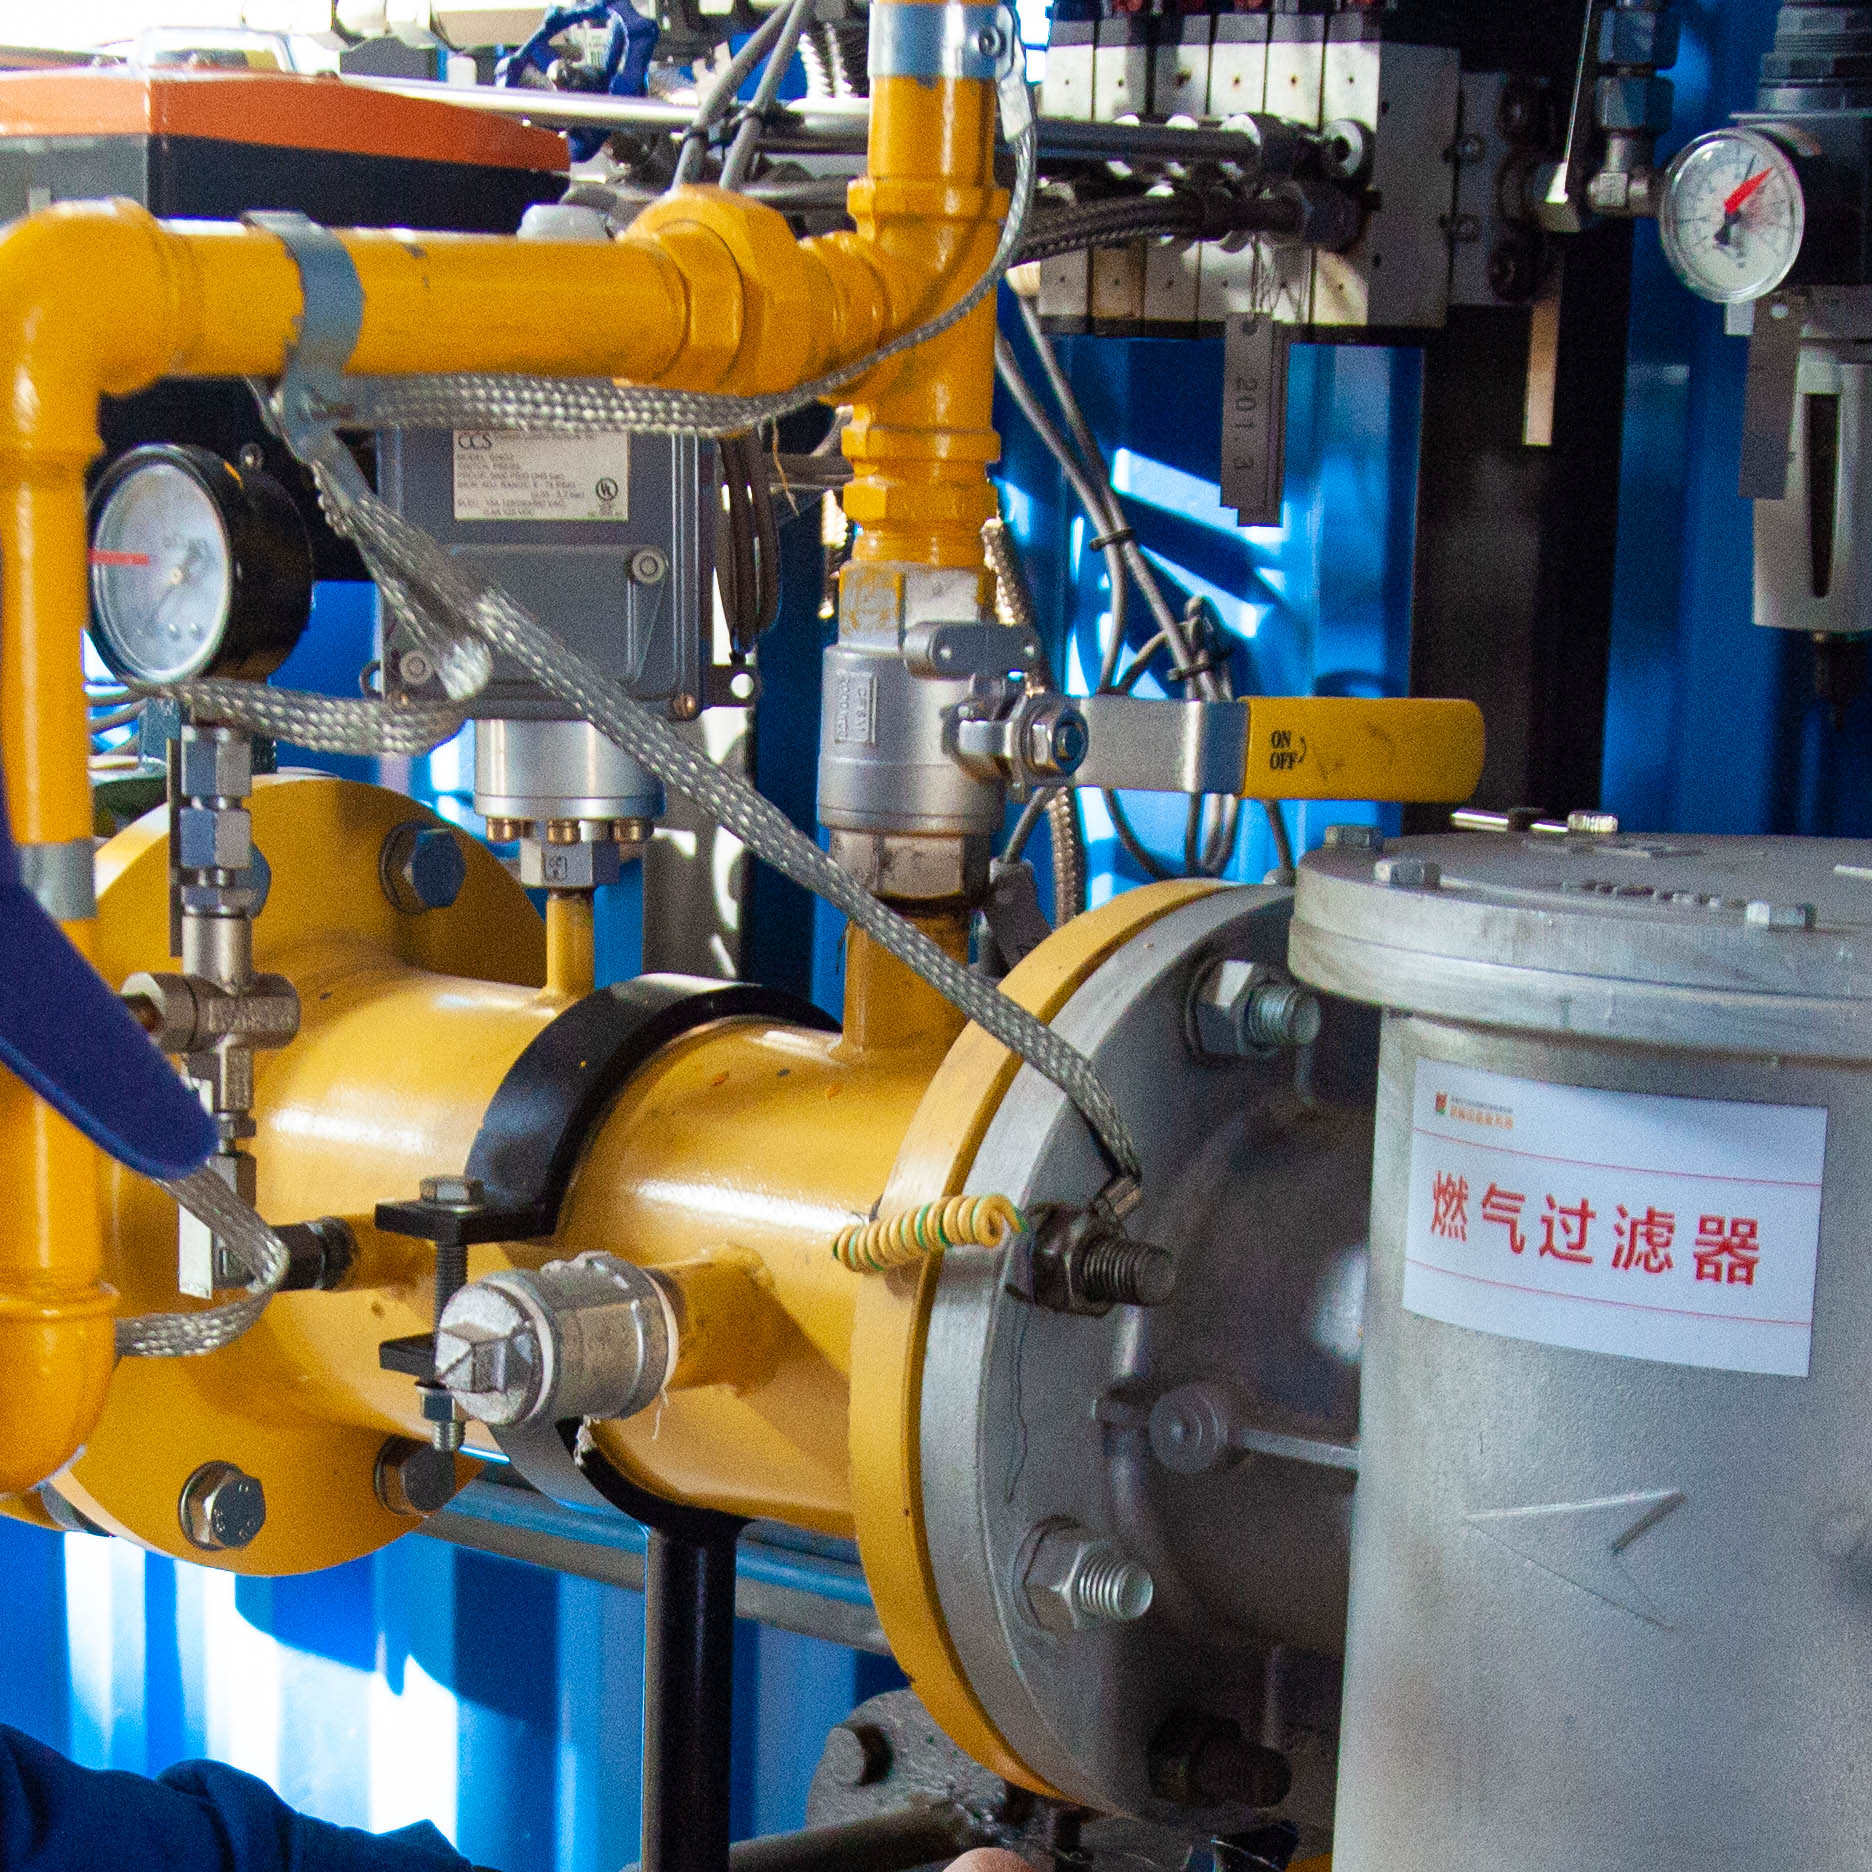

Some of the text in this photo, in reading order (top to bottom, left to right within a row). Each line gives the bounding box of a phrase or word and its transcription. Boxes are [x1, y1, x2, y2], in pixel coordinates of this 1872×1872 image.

[1271, 729, 1291, 749] ON
[1269, 751, 1296, 770] OFF
[1430, 1169, 1760, 1287] 燃气过滤器
